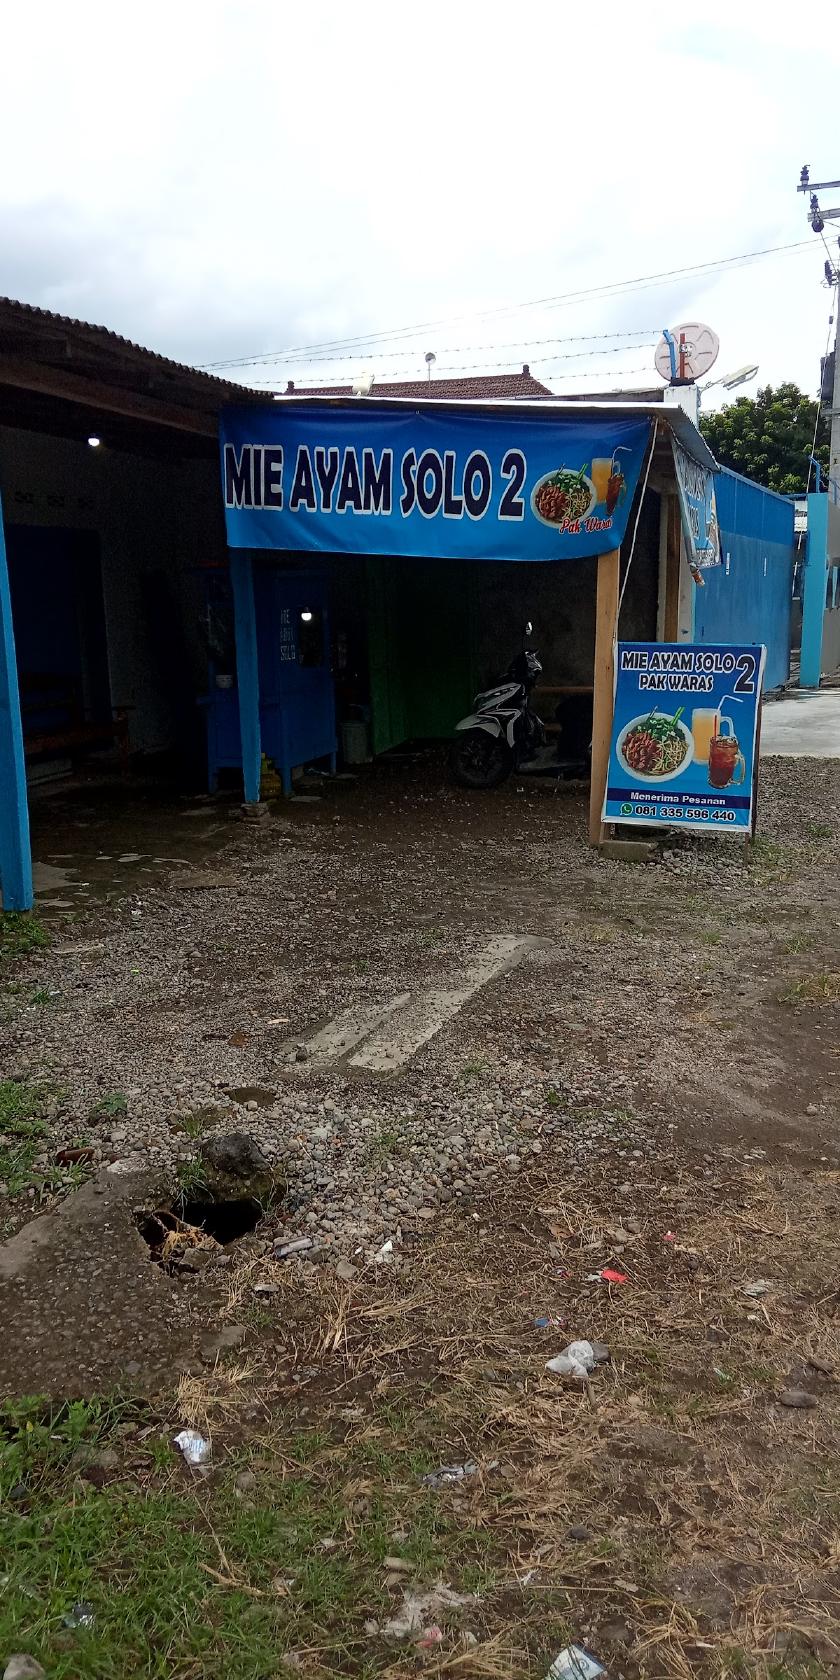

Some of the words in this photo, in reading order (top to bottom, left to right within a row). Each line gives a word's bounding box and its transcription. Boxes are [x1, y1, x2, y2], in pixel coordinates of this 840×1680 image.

[224, 443, 283, 512] MIE
[290, 445, 393, 516] AYAM
[400, 447, 492, 520] SOLO
[498, 448, 528, 522] 2
[559, 517, 582, 535] Pak
[621, 651, 648, 671] MIE
[649, 652, 693, 672] AYAM
[696, 653, 734, 673] SOLO
[734, 655, 756, 694] 2
[639, 673, 667, 691] PAK
[668, 674, 714, 692] WARAS
[630, 791, 680, 803] Menerima
[682, 794, 726, 806] Pesanan
[635, 805, 657, 816] 081
[660, 806, 683, 818] 335
[686, 807, 709, 819] 596
[711, 809, 736, 821] 440
